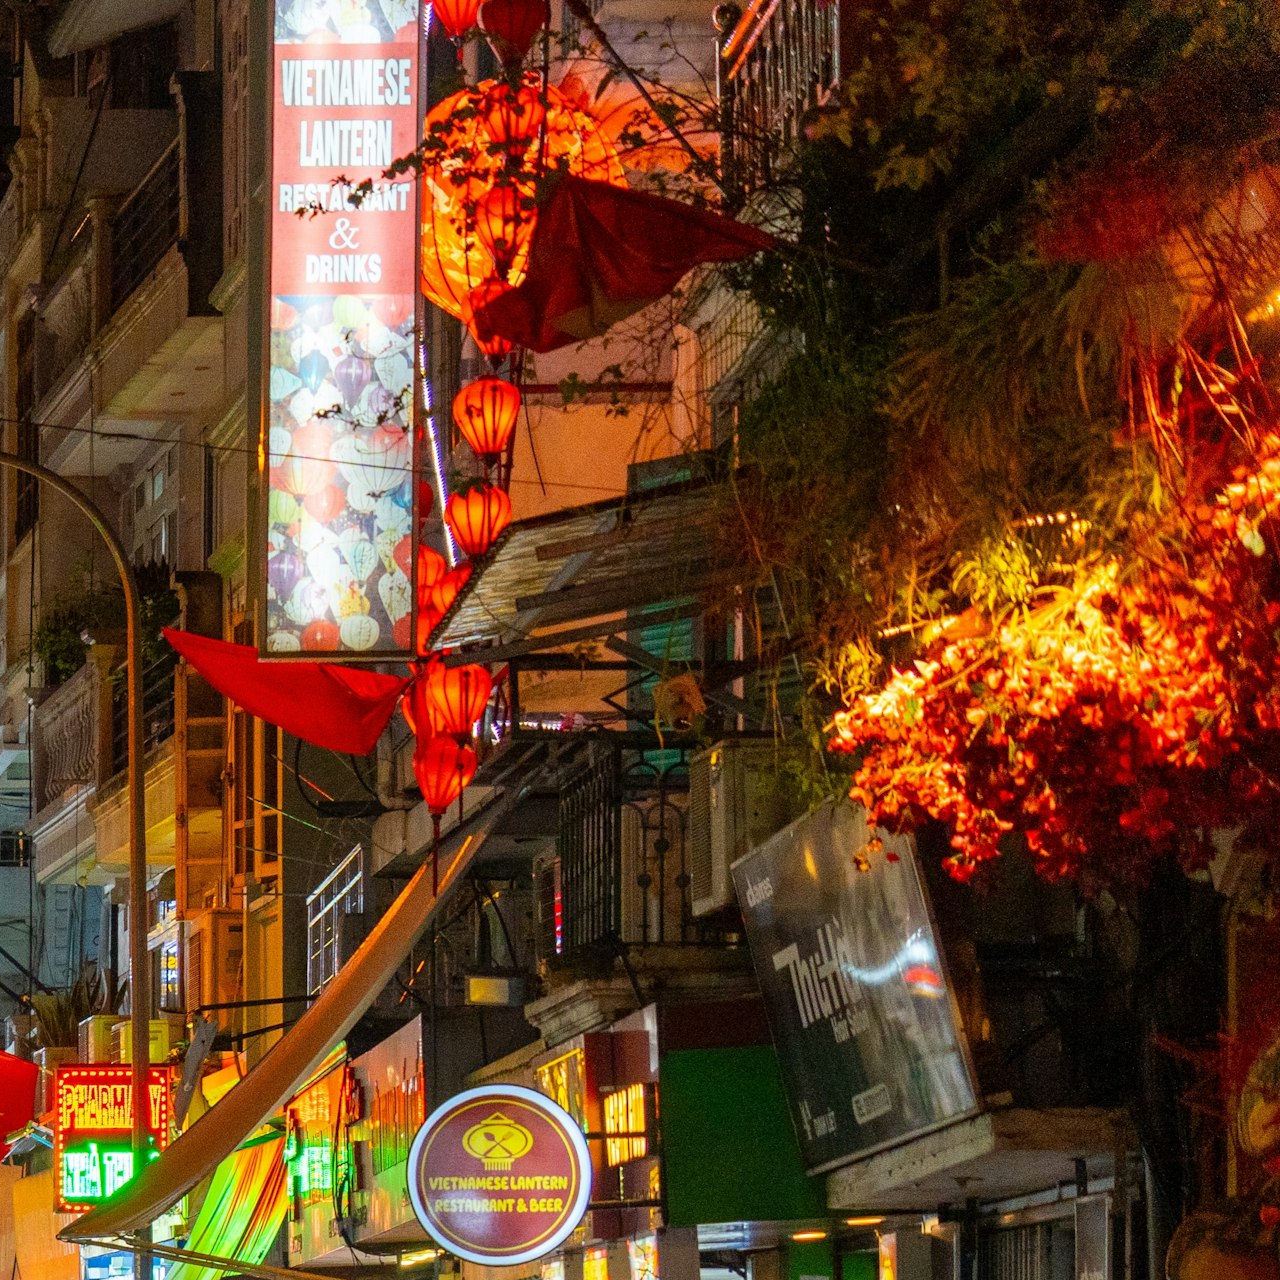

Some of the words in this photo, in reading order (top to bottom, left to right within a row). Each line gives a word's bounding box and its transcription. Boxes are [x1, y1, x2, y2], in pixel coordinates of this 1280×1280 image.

[281, 57, 412, 106] VIETNAMESE
[299, 119, 393, 167] LANTERN
[329, 217, 360, 249] &
[305, 254, 382, 283] DRINKS
[428, 1176, 508, 1191] VIETNAMESE
[510, 1176, 568, 1190] LANTERN
[434, 1198, 514, 1213] RESTAURANT
[516, 1198, 527, 1212] &
[530, 1198, 563, 1212] BEER
